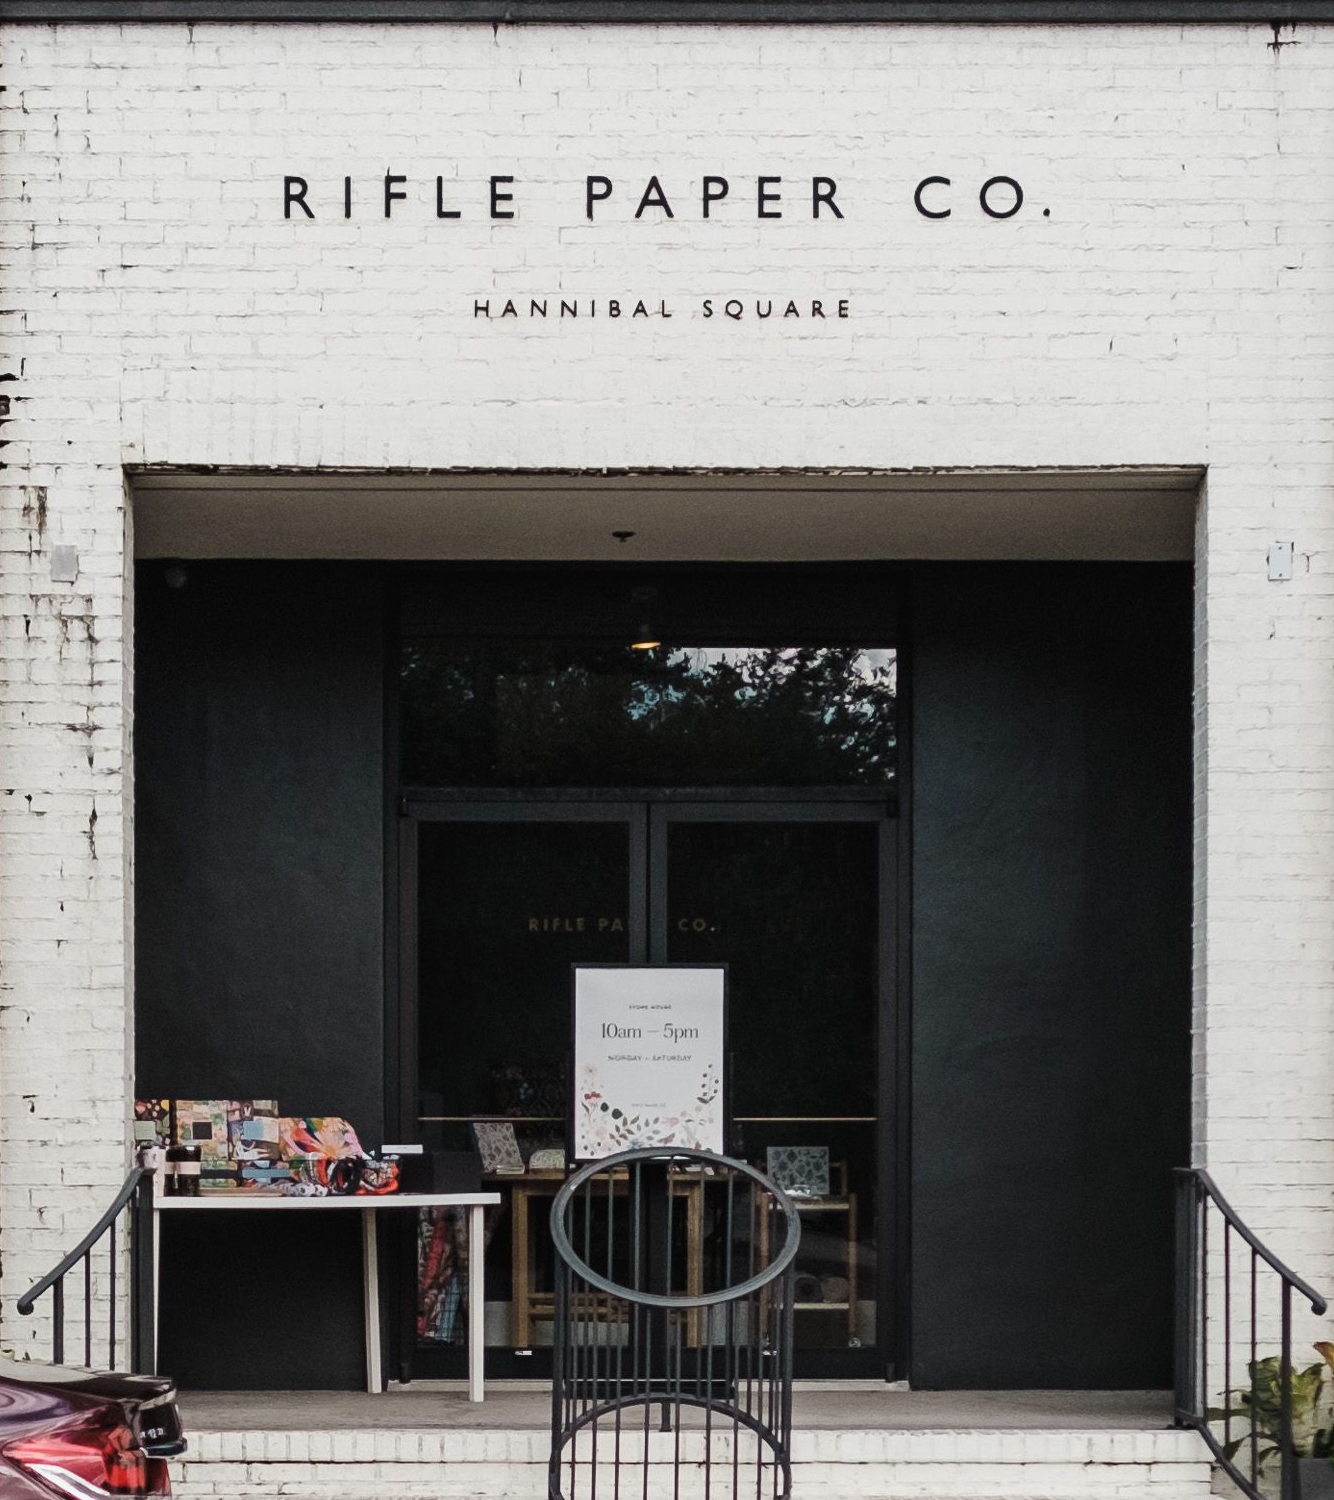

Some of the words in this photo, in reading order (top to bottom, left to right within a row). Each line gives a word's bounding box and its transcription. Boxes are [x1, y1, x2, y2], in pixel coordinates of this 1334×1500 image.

[283, 175, 517, 220] RIFLE
[586, 175, 845, 221] PAPER
[913, 175, 1053, 220] CO.
[474, 299, 674, 319] HANNIBAL
[702, 299, 852, 321] SQUARE
[528, 917, 586, 932] RIFLE
[601, 1022, 642, 1039] 10am
[663, 1022, 699, 1044] 5pm
